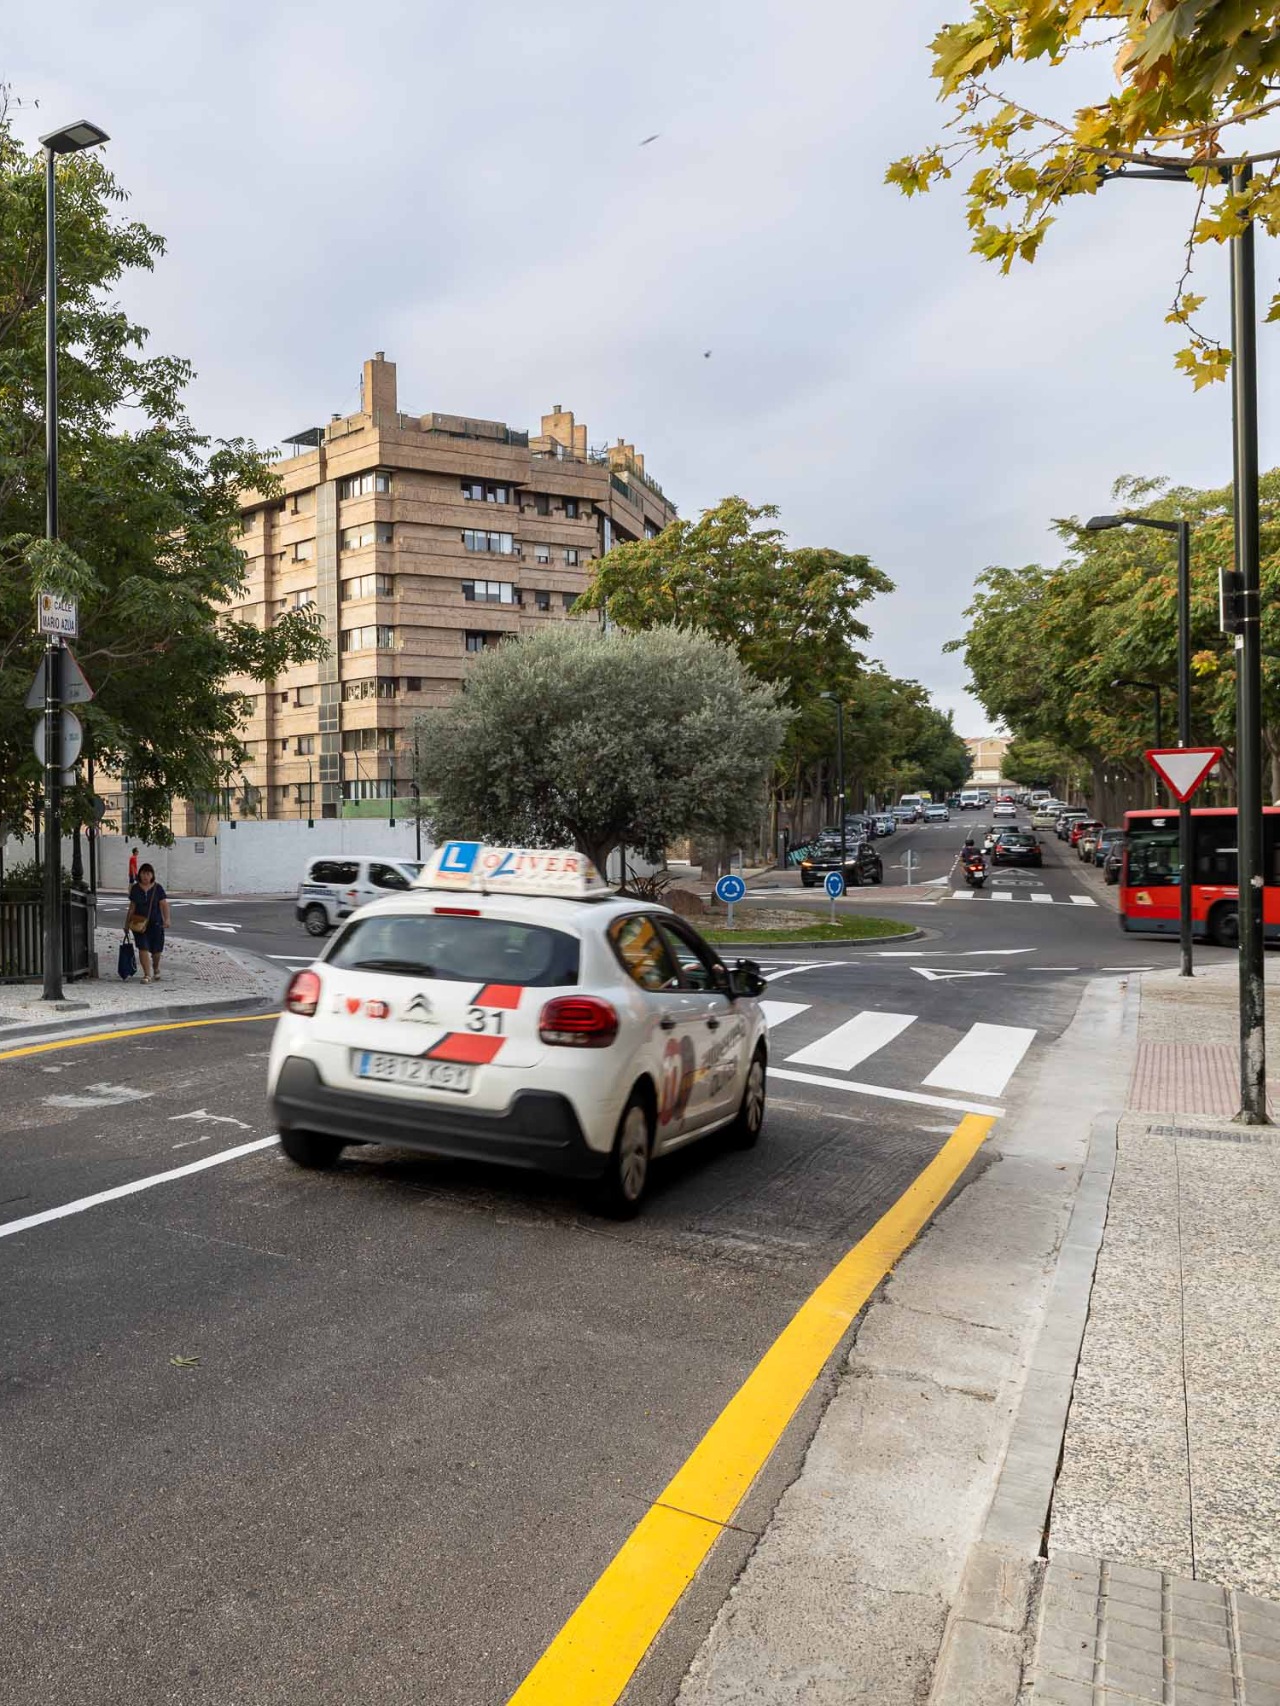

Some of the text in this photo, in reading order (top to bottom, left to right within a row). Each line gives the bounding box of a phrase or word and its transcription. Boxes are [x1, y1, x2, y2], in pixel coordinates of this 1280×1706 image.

[54, 601, 72, 612] CALLE
[43, 615, 59, 629] MARIO
[445, 846, 467, 868] L
[482, 852, 579, 878] OLIVER
[466, 1007, 504, 1035] 31
